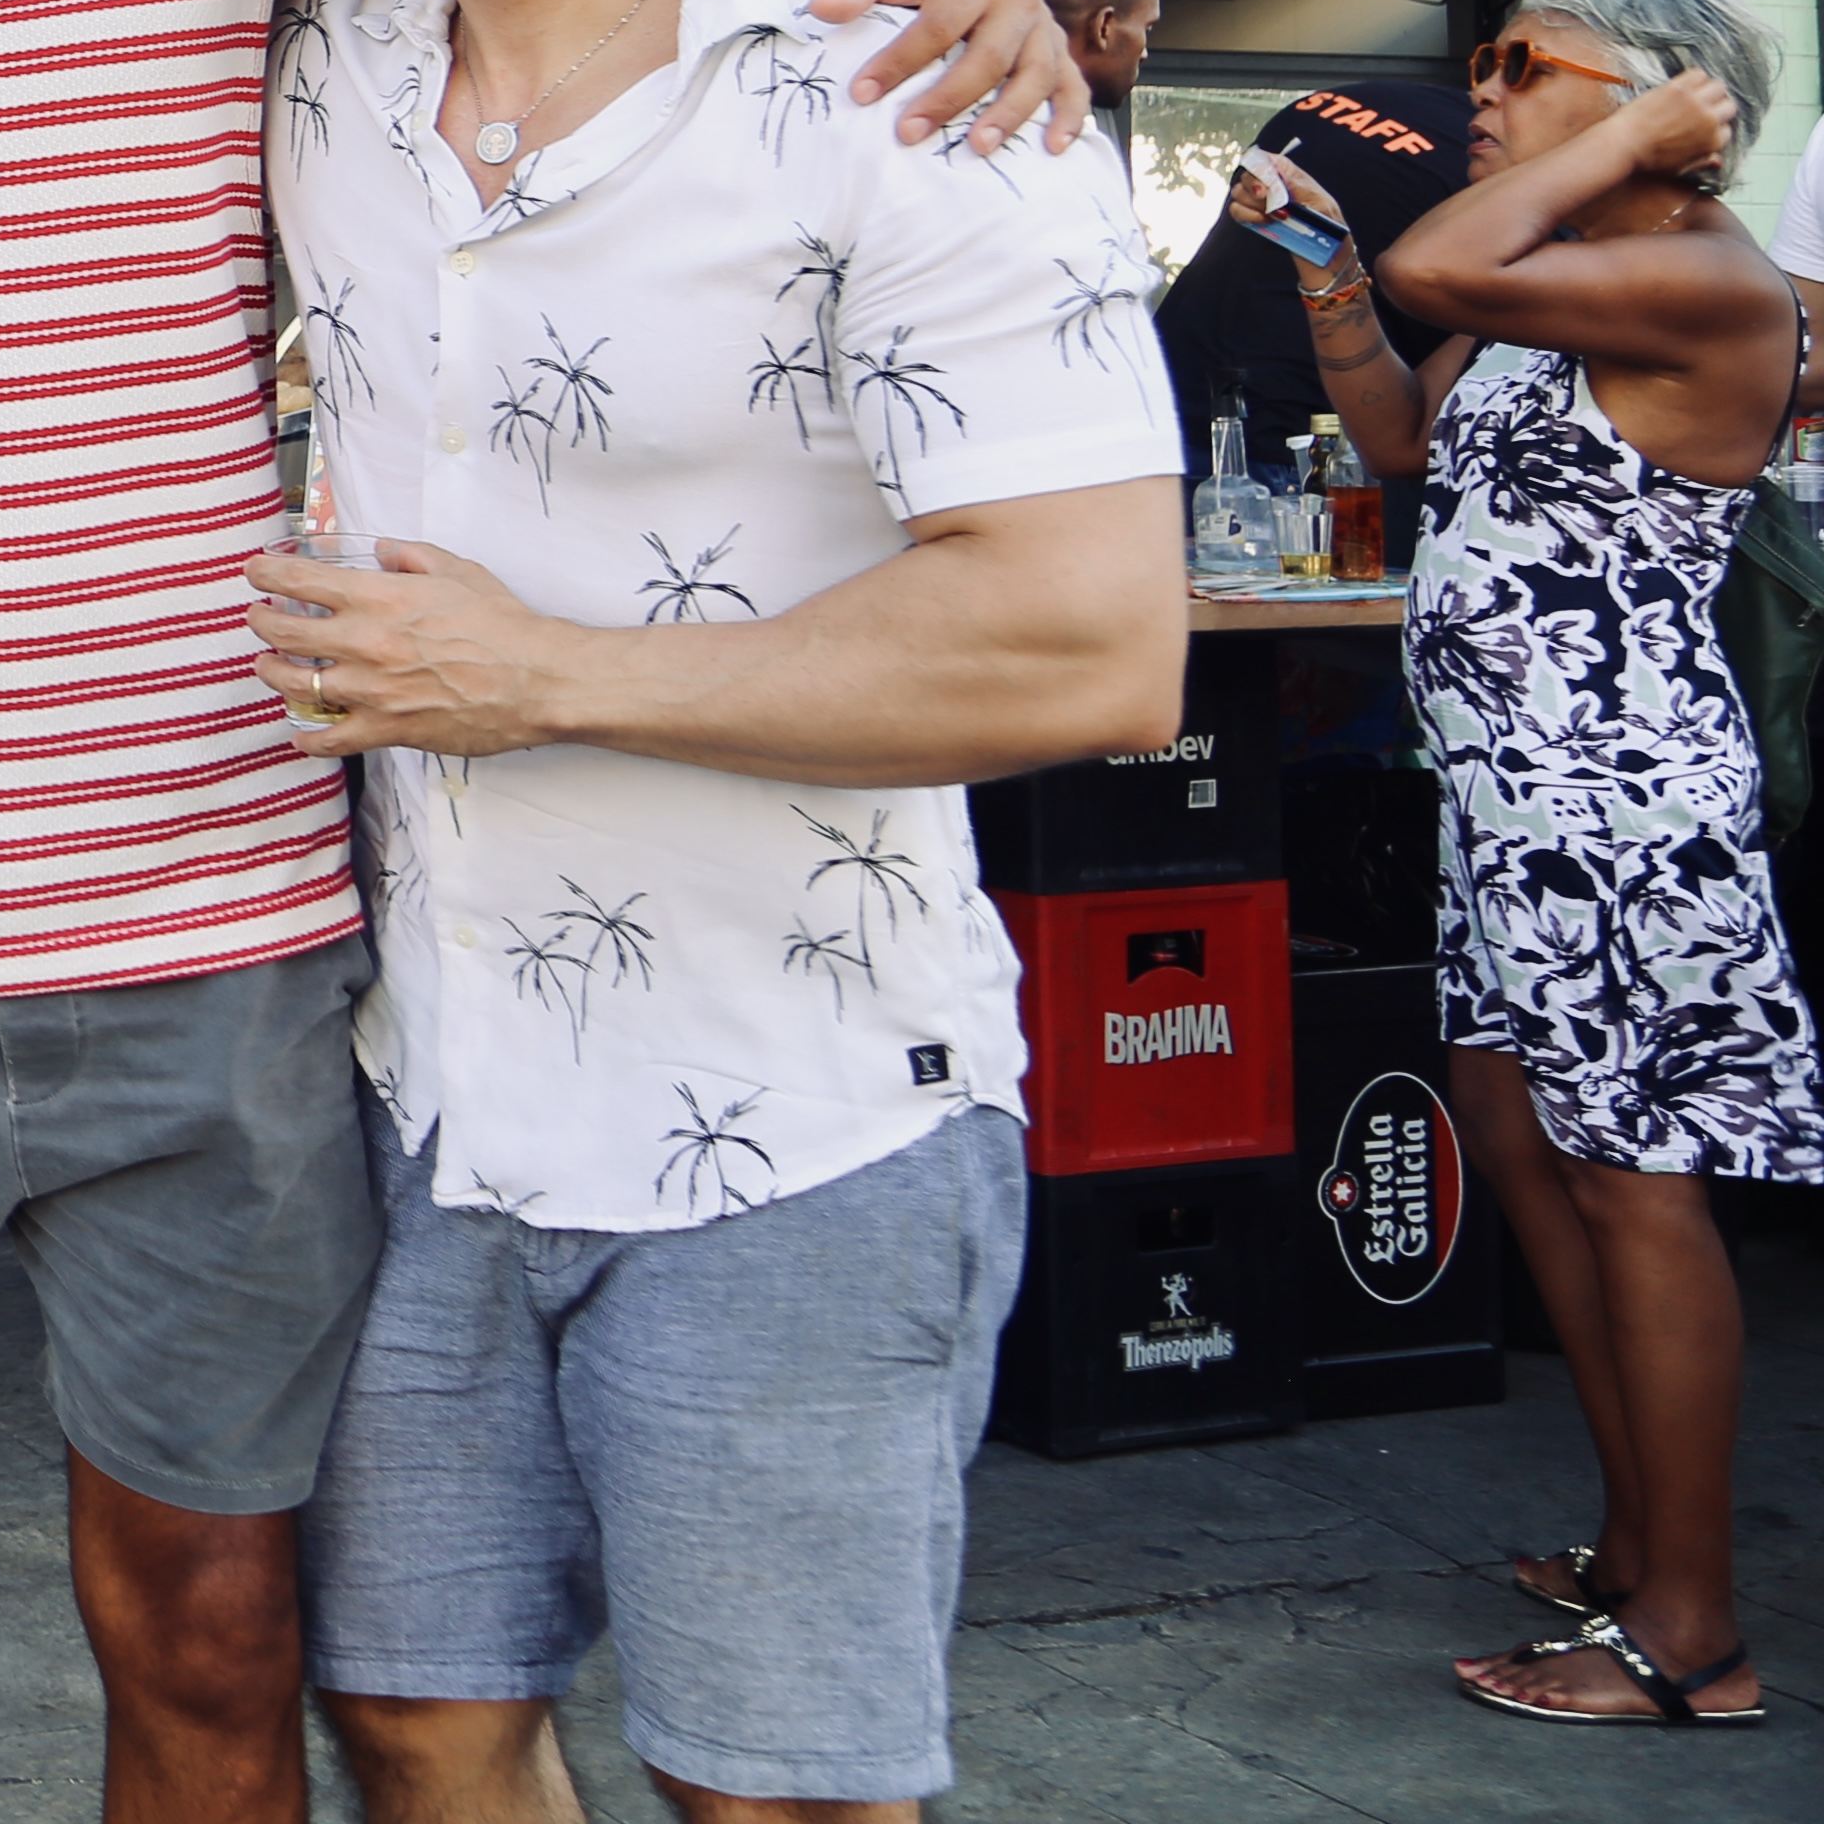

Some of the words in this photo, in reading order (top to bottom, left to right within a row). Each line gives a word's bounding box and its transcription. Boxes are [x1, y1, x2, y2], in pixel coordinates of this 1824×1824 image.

[1295, 92, 1435, 155] STAFF
[1104, 1004, 1233, 1065] BRAHMA
[1363, 1113, 1395, 1265] Estrella
[1396, 1118, 1429, 1257] Galicia
